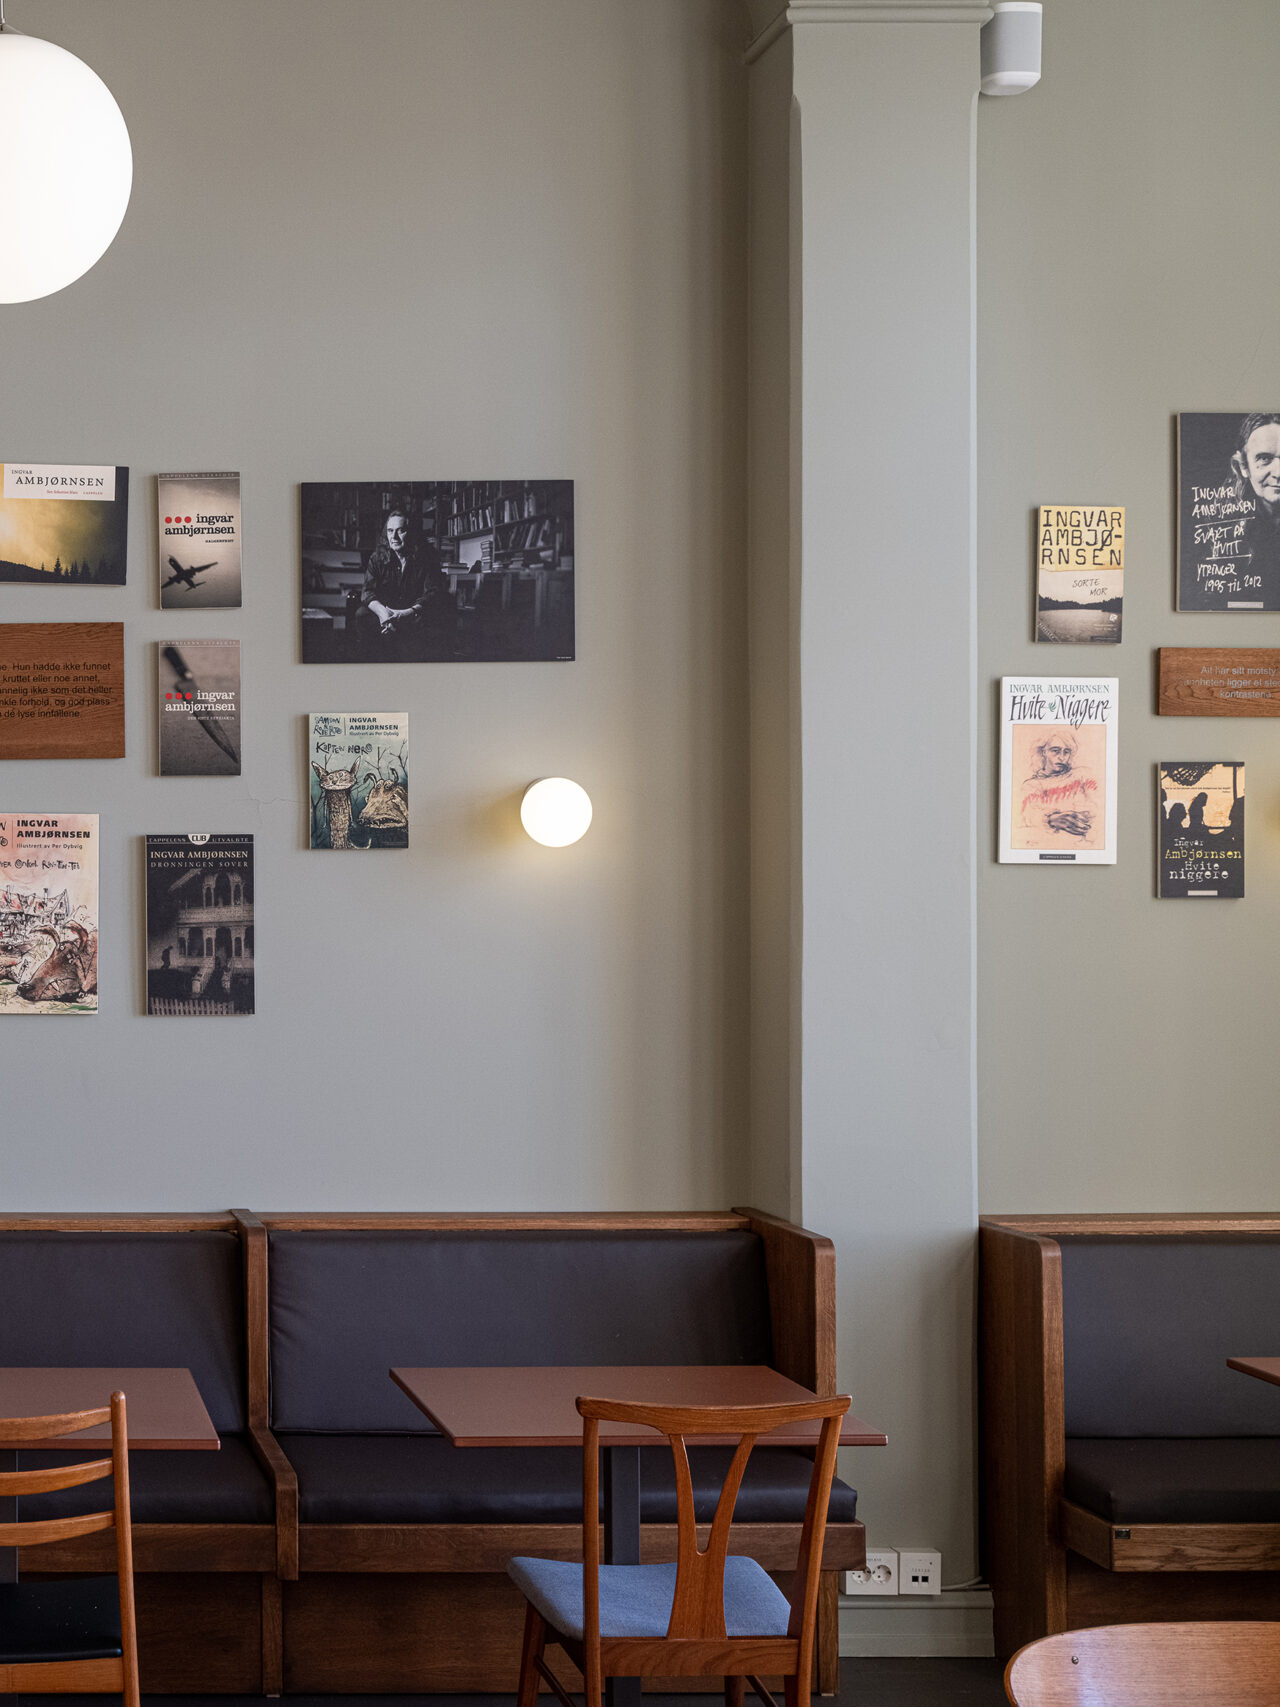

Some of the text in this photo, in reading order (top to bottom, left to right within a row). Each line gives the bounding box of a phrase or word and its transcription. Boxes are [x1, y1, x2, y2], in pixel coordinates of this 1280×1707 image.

[15, 476, 105, 487] AMBJØRNSEN
[1191, 486, 1236, 502] INGVAR
[196, 513, 235, 526] ingvar
[1042, 509, 1122, 528] INGVAR
[164, 525, 236, 537] ambjørnsen
[1194, 520, 1246, 544] SVART PÅ
[1041, 527, 1123, 551] AMBJØ-
[1211, 540, 1242, 558] HVITT
[1041, 548, 1122, 566] RNSEN
[1072, 578, 1101, 589] SORTE
[1089, 587, 1108, 596] MOR
[12, 662, 31, 671] Hun
[33, 662, 61, 671] hadde
[83, 662, 111, 671] funnet
[1009, 684, 1110, 693] INGVAR AMBJØRNSEN
[1226, 678, 1251, 689] ligger
[50, 686, 70, 694] som
[196, 690, 236, 702] ingvar
[164, 701, 237, 714] ambjørnsen
[1008, 694, 1112, 730] Hvite Niggere
[16, 819, 58, 827] INGVAR
[16, 830, 91, 839] AMBJØRNSEN
[1173, 837, 1204, 848] Ingvar
[150, 850, 249, 860] INGVAR AMBJØRNSEN
[1165, 848, 1242, 861] Ambjørnsen
[1185, 861, 1220, 871] Hvite
[1169, 869, 1229, 883] niggere
